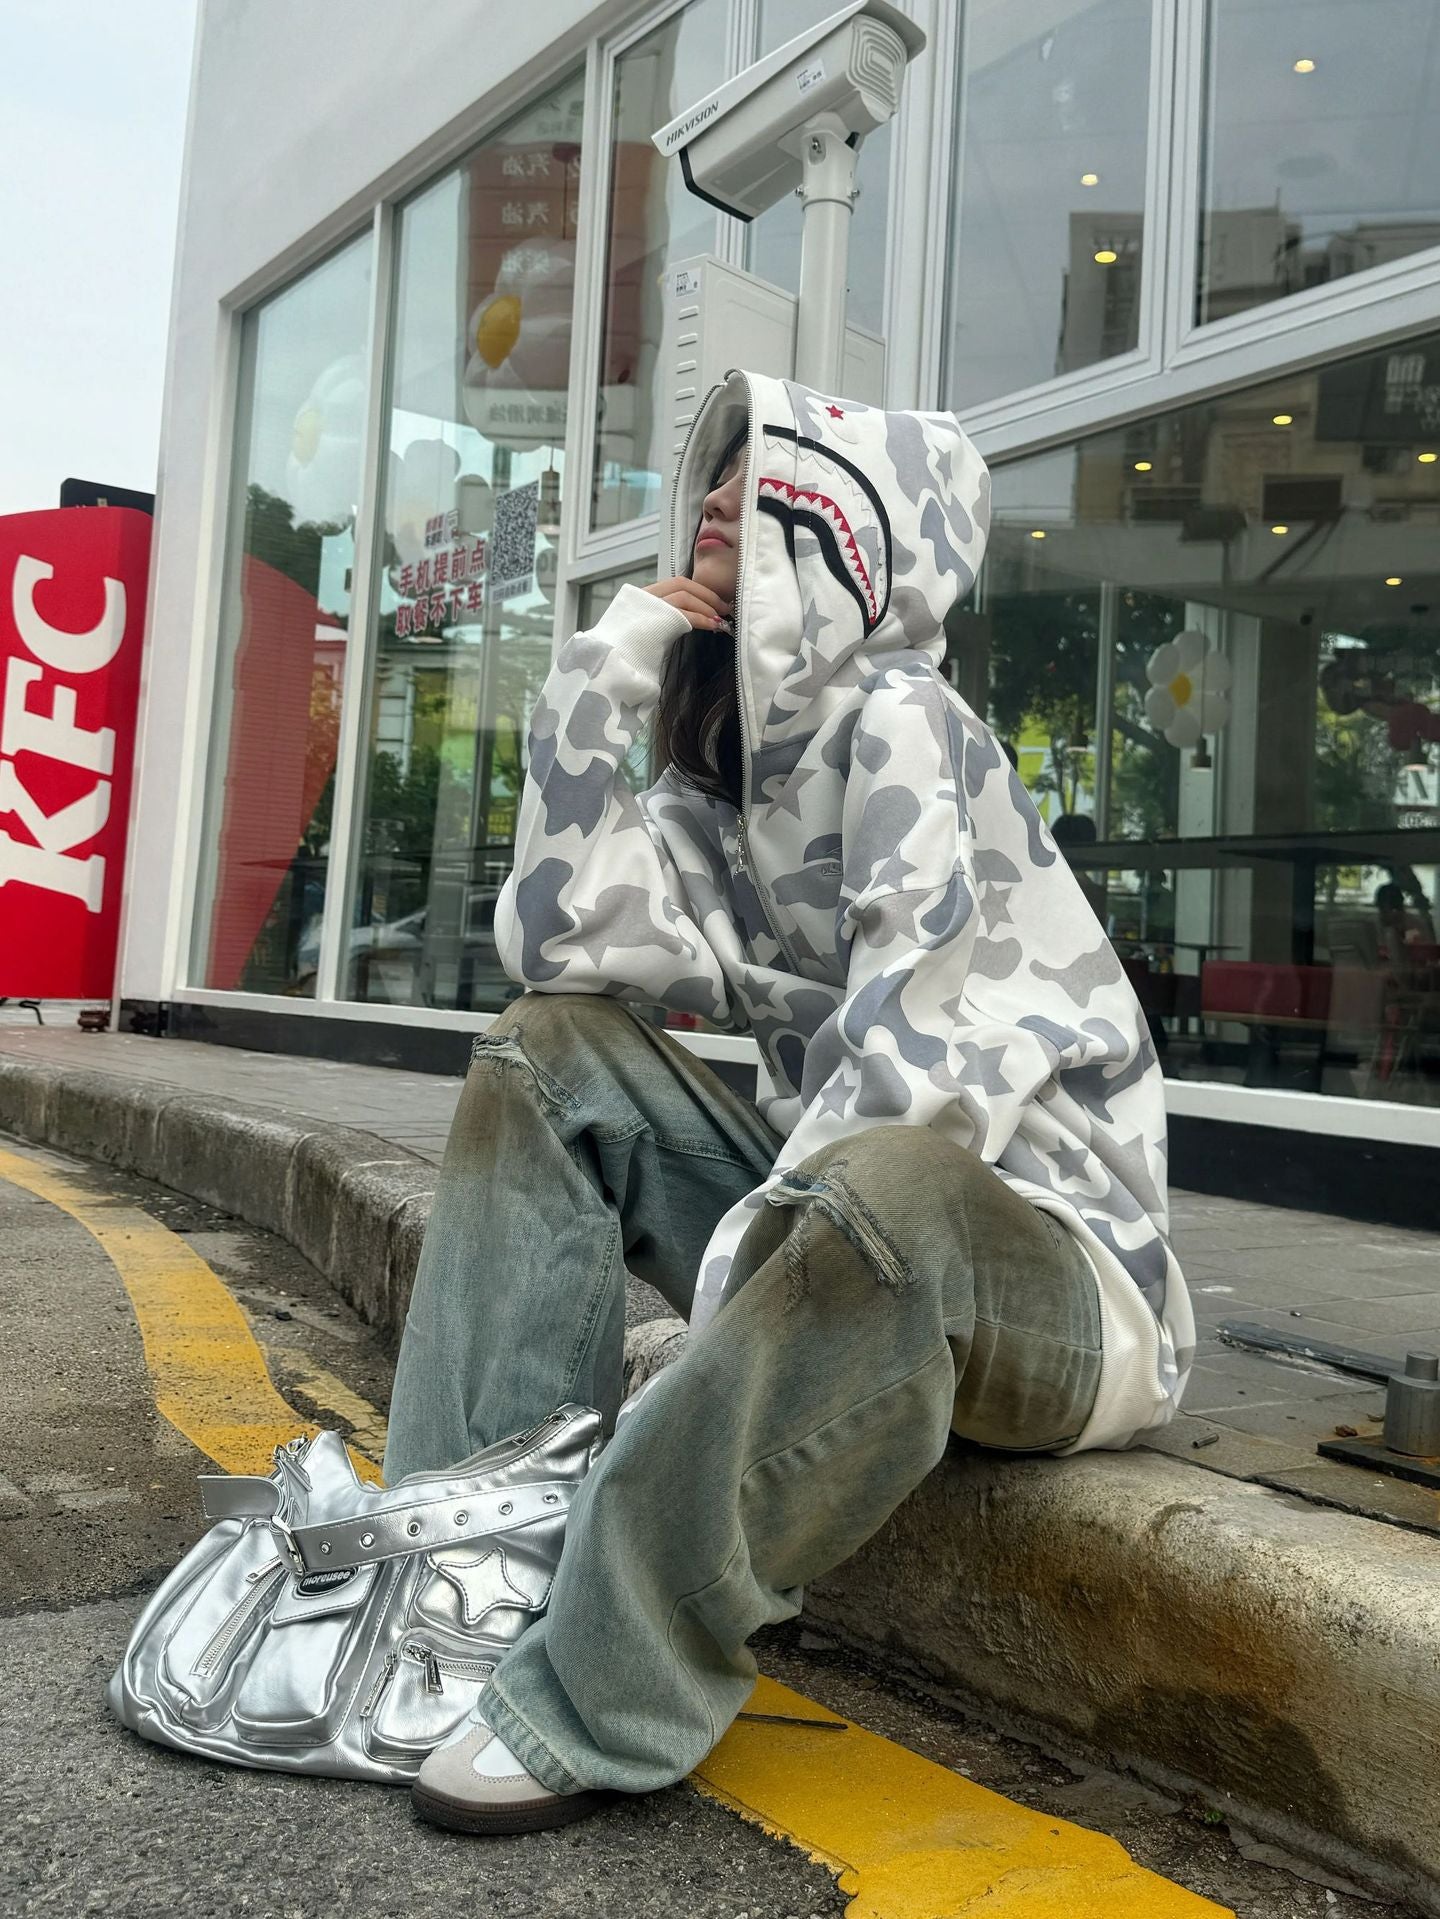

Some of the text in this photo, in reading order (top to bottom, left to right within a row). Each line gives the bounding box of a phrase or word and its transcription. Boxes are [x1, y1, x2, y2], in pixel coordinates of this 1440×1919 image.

[666, 103, 719, 146] HIKVISION
[399, 540, 486, 598] 手机提前点
[395, 582, 483, 638] 取餐不下车
[0, 553, 127, 914] KFC
